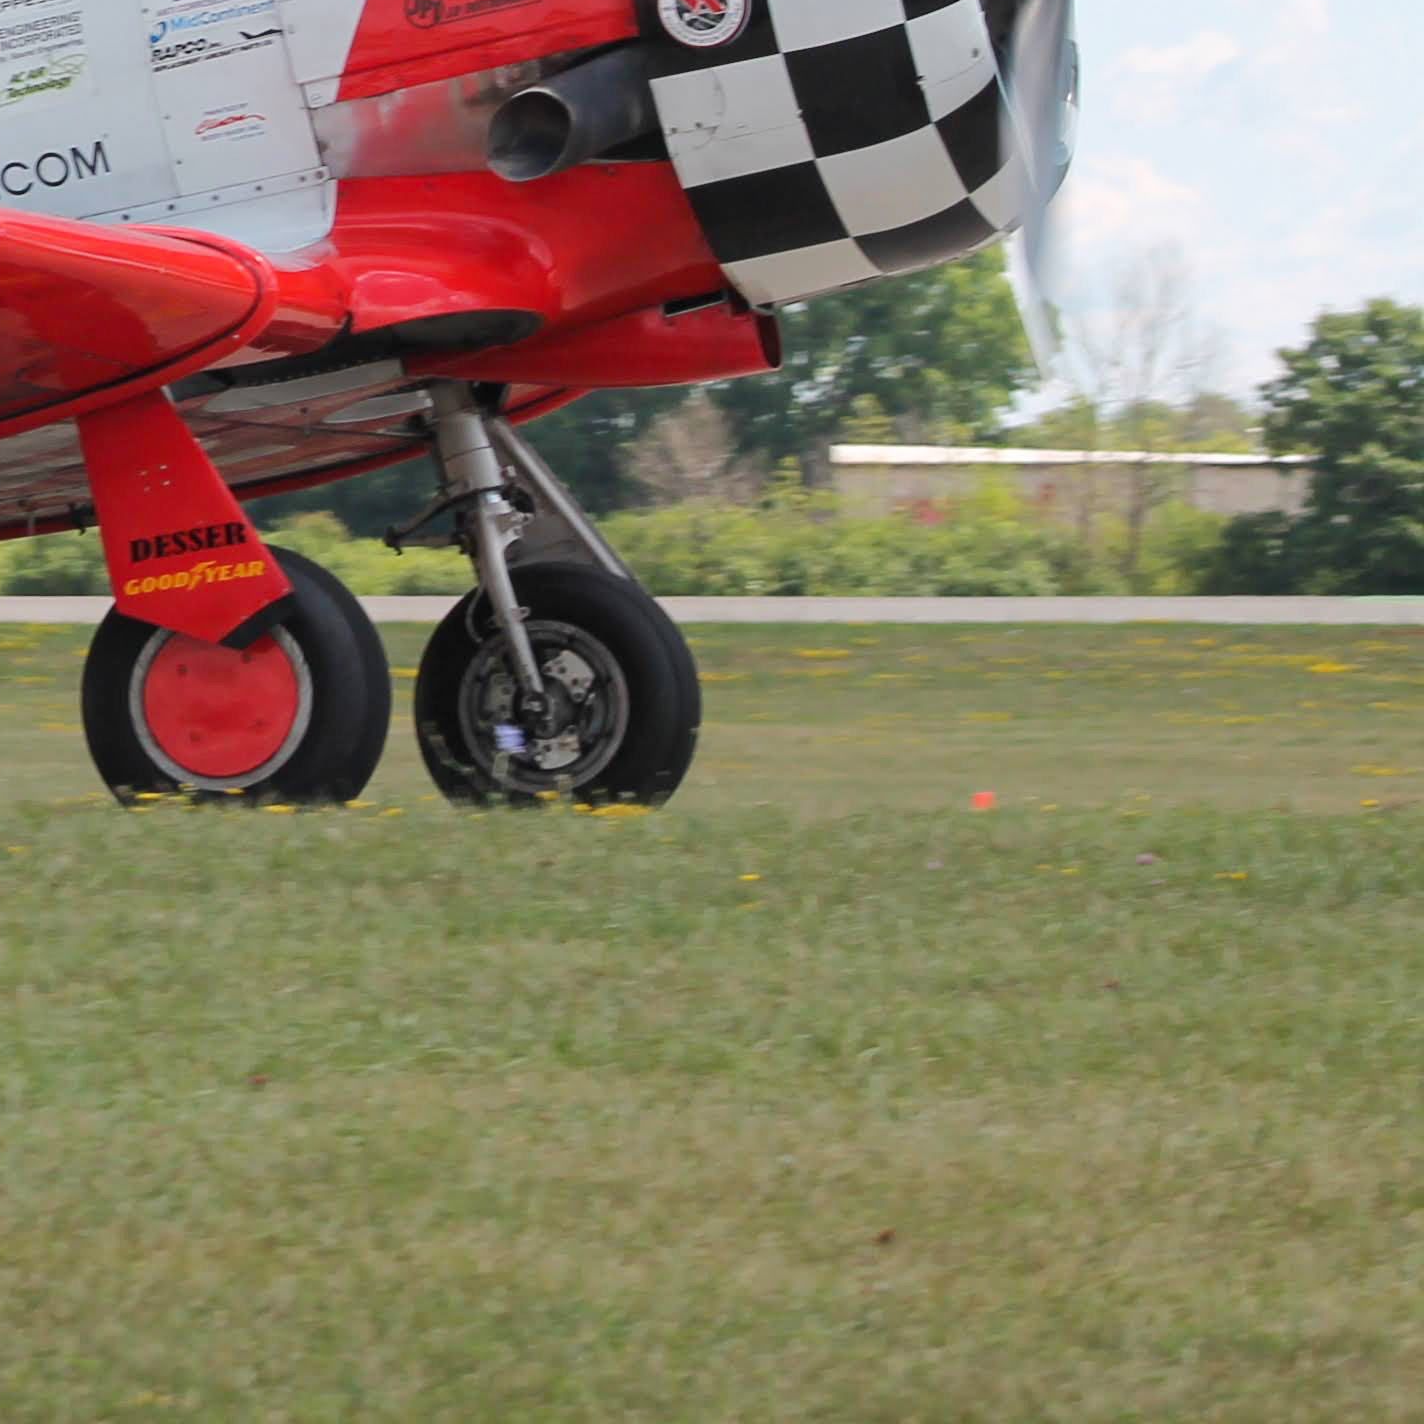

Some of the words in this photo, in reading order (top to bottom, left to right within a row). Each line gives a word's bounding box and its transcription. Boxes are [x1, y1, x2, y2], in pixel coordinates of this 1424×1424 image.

[5, 76, 73, 99] Technology
[129, 521, 247, 564] DESSER
[123, 560, 266, 596] GOODYEAR
